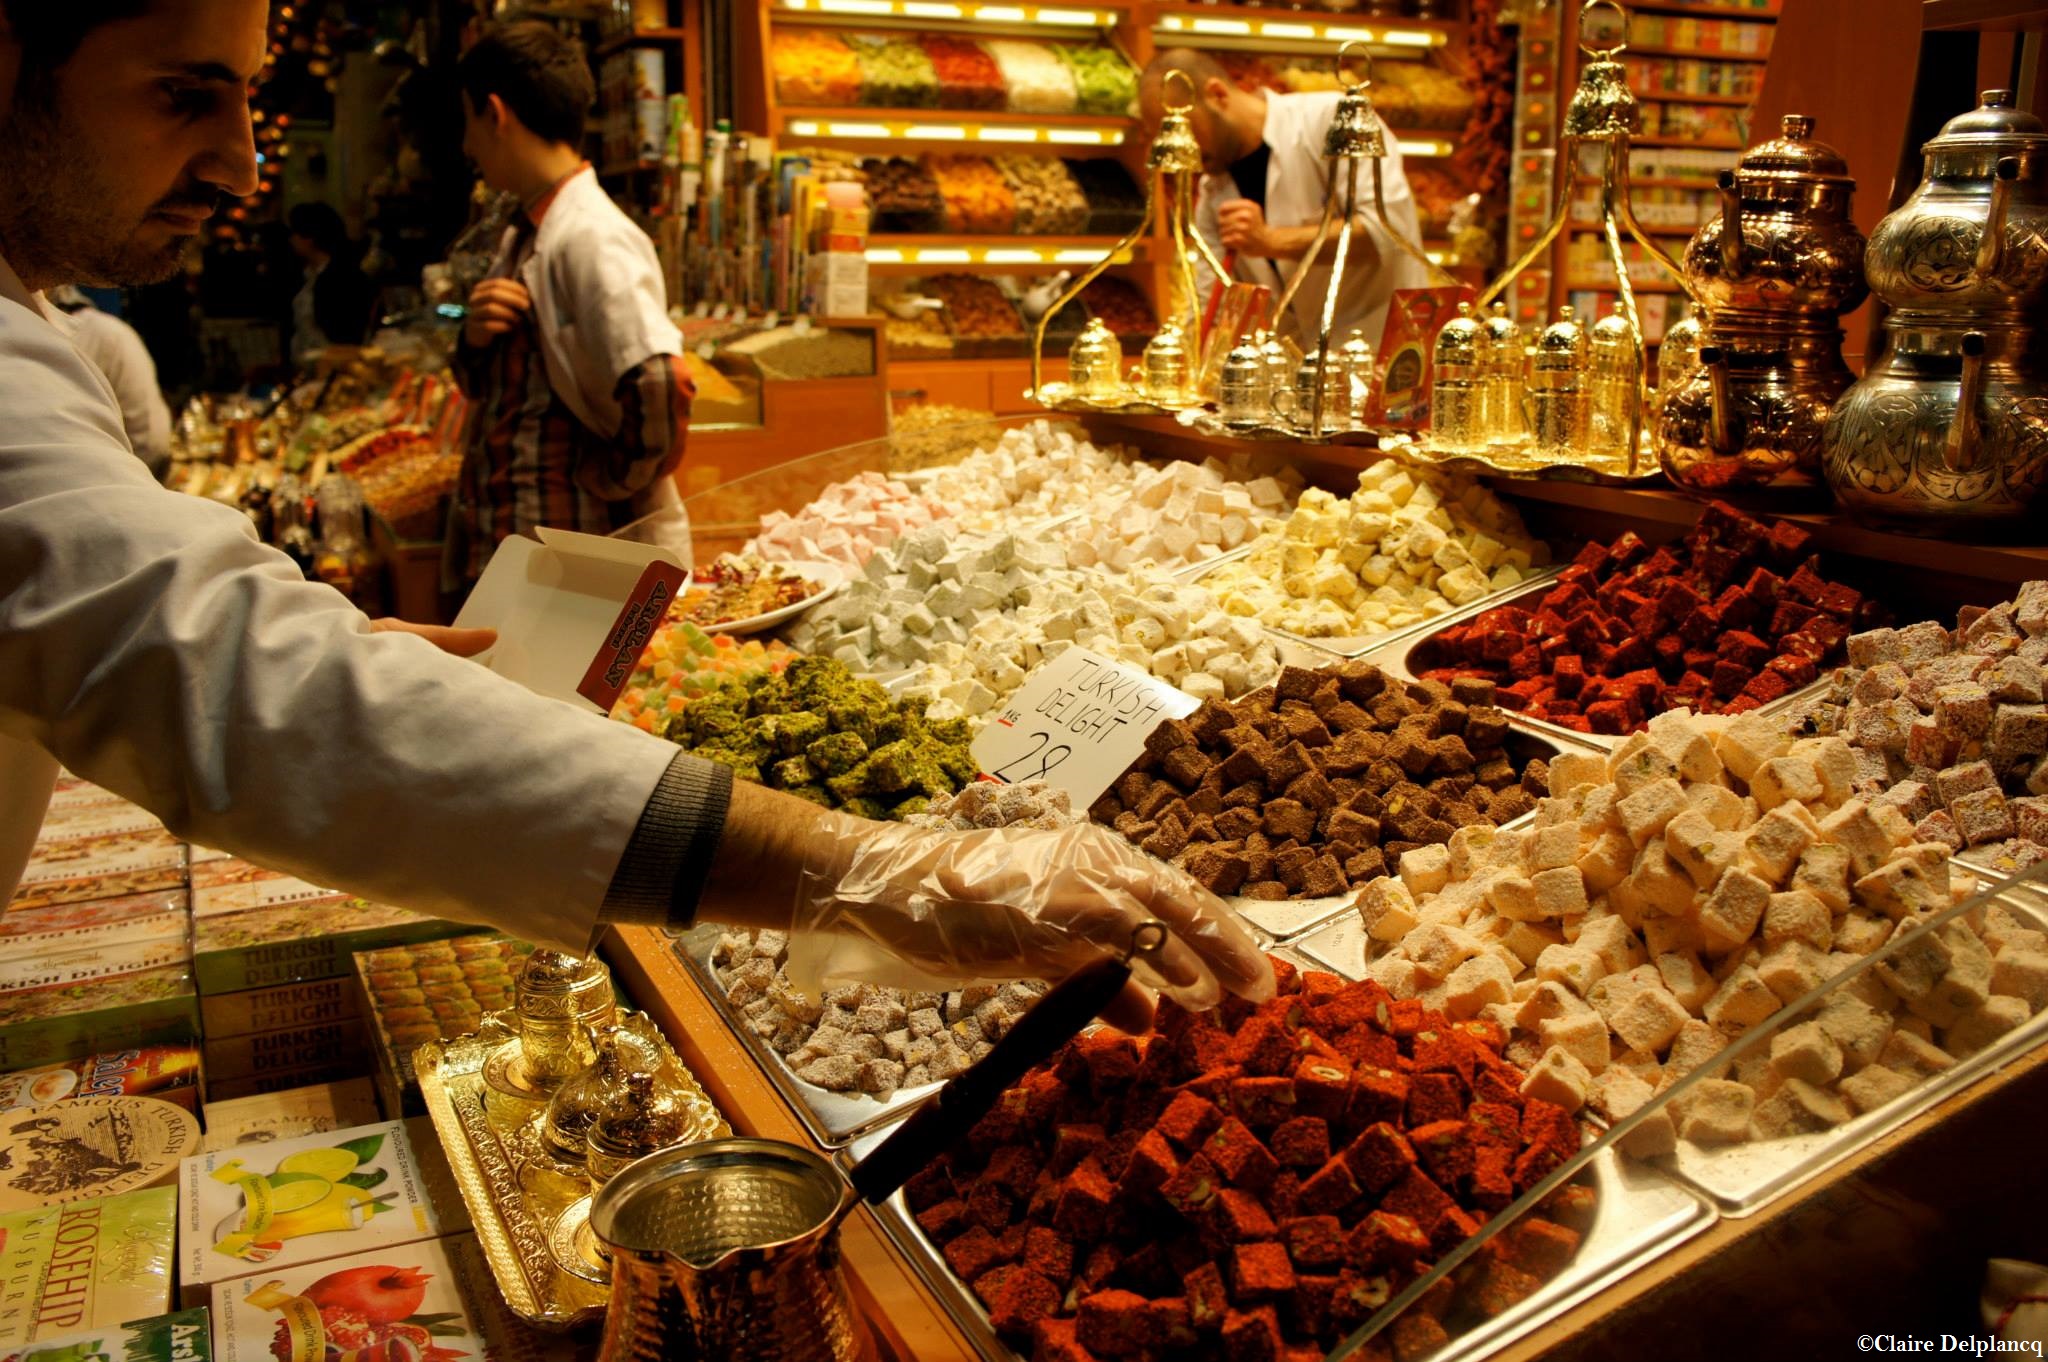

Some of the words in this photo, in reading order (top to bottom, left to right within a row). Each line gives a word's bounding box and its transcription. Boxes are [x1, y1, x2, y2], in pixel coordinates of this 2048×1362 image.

[604, 580, 668, 689] ARSLAN
[1067, 658, 1166, 725] TURKISH
[1035, 688, 1129, 744] DELIGHT
[992, 731, 1072, 783] 28
[72, 955, 170, 980] DELIGHT
[244, 939, 336, 966] TURKISH
[251, 983, 341, 1010] TURKISH
[251, 1001, 341, 1028] DELIGHT
[252, 1024, 342, 1052] TURKISH
[252, 1041, 342, 1070] DELIGHT
[32, 1099, 146, 1114] FAMOUS
[152, 1105, 188, 1155] TURKISH
[37, 1207, 101, 1328] ROSEHIP
